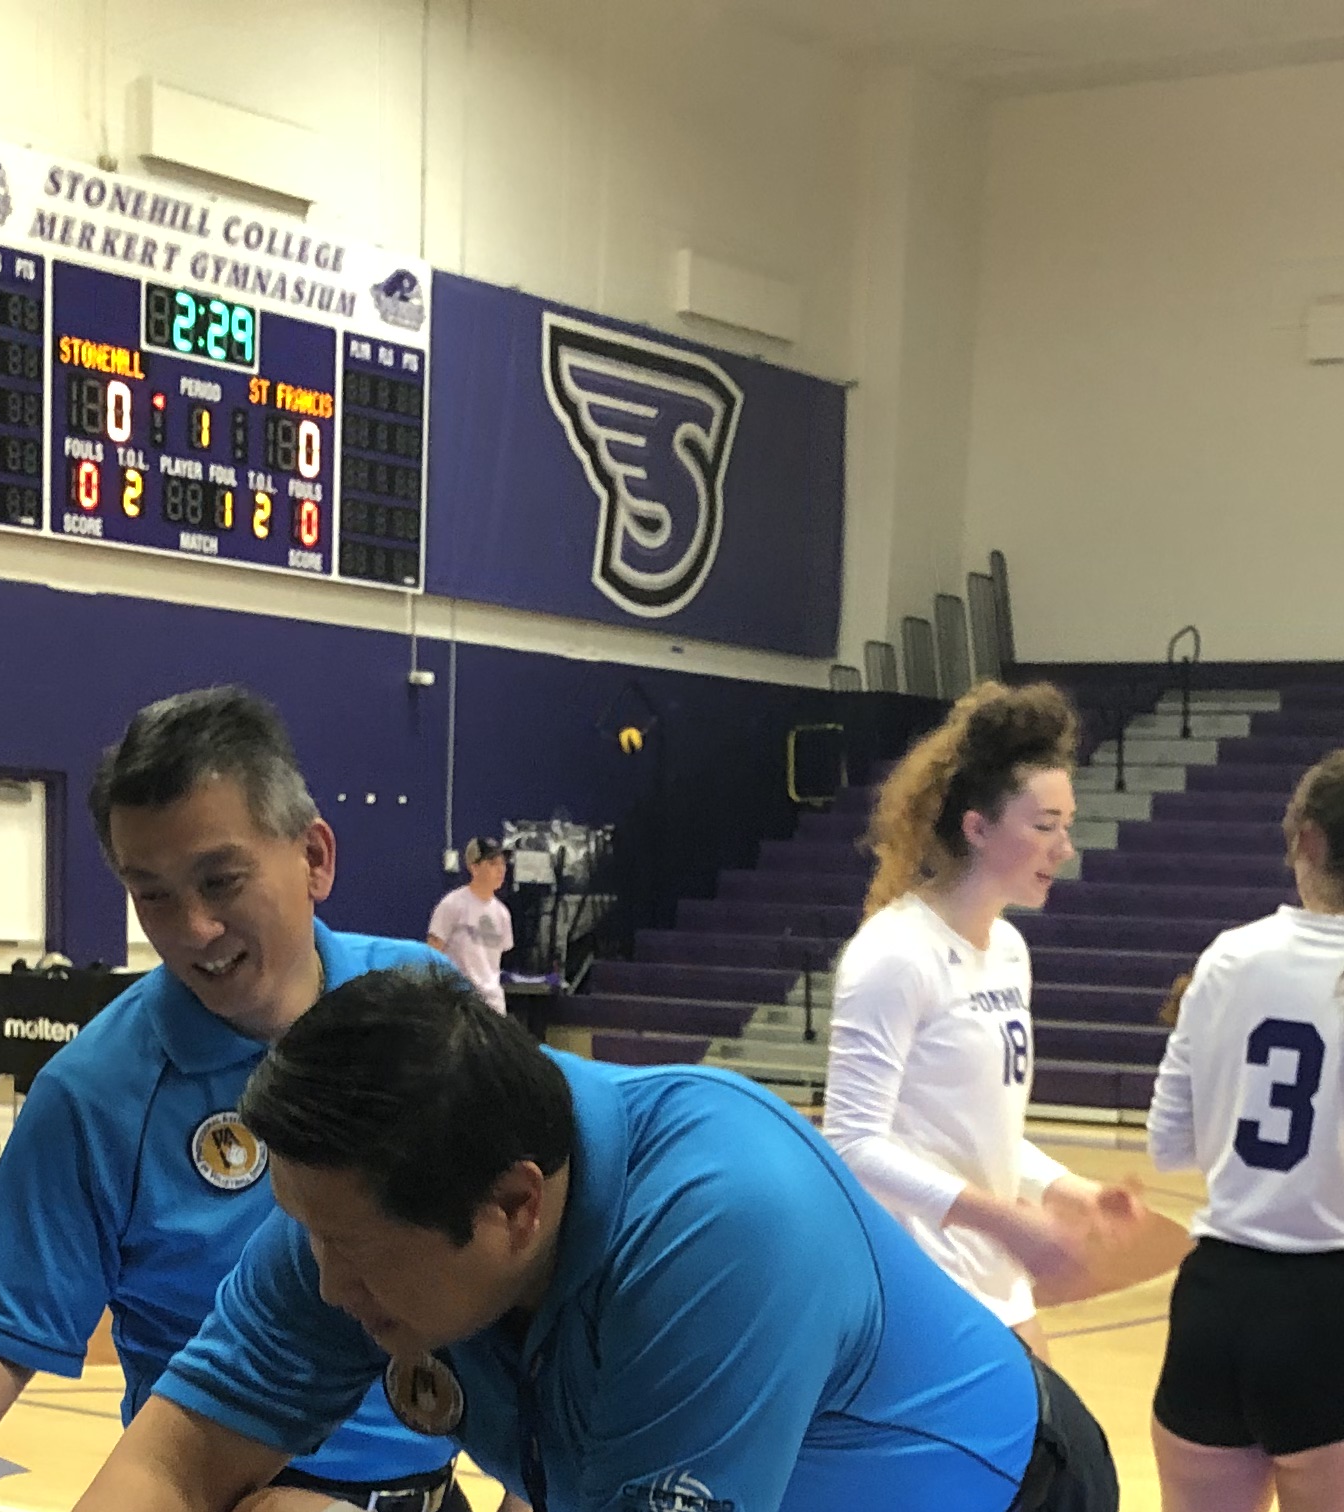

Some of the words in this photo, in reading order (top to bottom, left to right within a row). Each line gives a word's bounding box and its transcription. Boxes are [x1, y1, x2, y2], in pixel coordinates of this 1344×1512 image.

[44, 164, 211, 239] STONEHILL
[222, 215, 346, 274] COLLEGE
[28, 207, 182, 273] MERKERT
[190, 250, 357, 318] GYMNASIUM
[172, 290, 254, 362] 2:29
[59, 334, 146, 380] STONEHILL
[106, 379, 132, 443] 0
[249, 375, 271, 405] ST
[276, 381, 333, 419] FRANCIS
[65, 436, 104, 463] FOULS
[200, 409, 211, 449] 1
[298, 419, 321, 480] 0
[78, 461, 100, 511] 0
[159, 453, 203, 481] PLAYER
[123, 468, 143, 518] 2
[224, 490, 233, 528] 1
[252, 491, 272, 540] 2
[300, 498, 319, 547] 0
[3, 1017, 80, 1043] molten
[998, 1019, 1029, 1088] 18
[1233, 1016, 1326, 1172] 3
